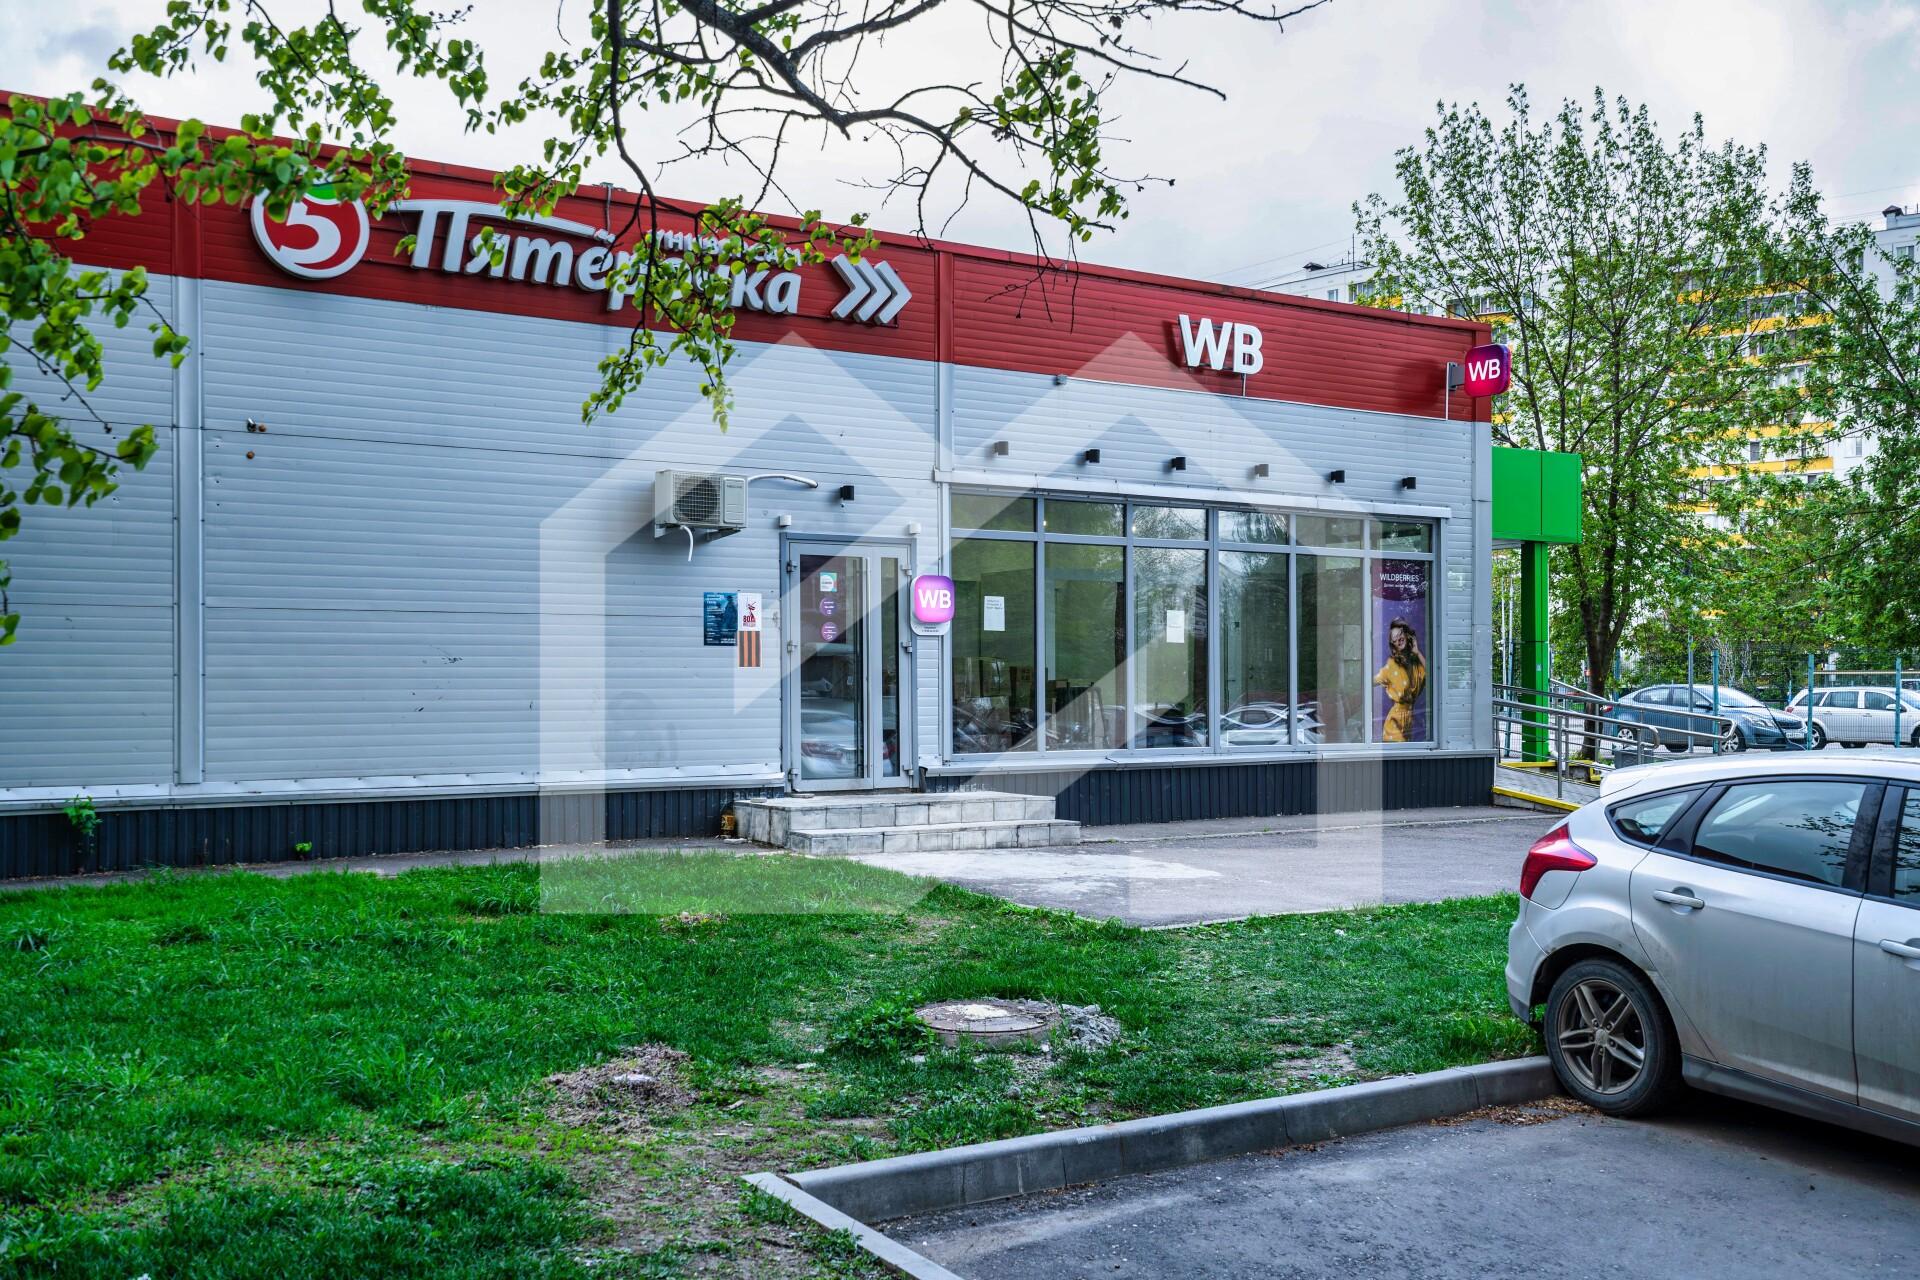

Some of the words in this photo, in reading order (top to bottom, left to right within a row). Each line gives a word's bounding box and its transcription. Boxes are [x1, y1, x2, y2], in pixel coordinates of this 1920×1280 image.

[645, 228, 803, 267] УНИВСАМ
[1177, 313, 1264, 376] WB
[1467, 358, 1501, 383] WB
[1379, 572, 1420, 583] WILDBERRIES
[918, 588, 952, 609] WB
